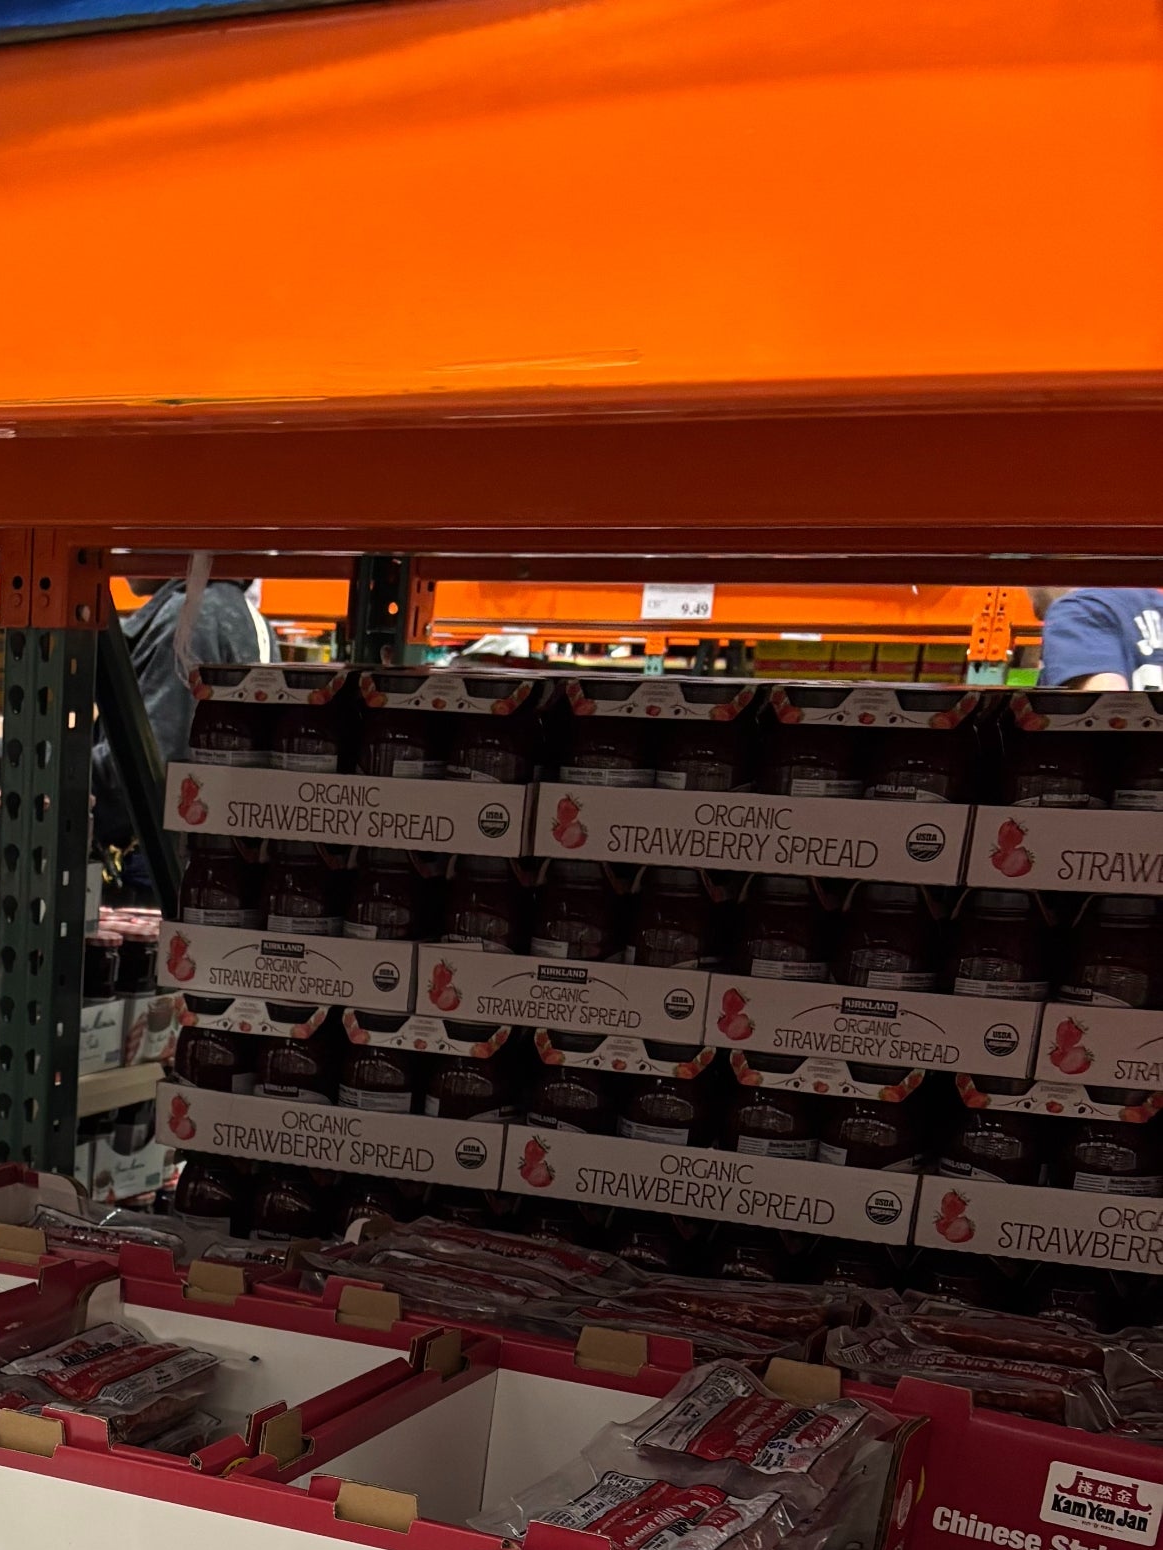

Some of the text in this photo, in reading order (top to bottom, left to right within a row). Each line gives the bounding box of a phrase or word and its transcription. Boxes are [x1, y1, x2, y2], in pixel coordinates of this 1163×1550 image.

[681, 603, 709, 615] 9.49
[298, 782, 380, 808] ORGANIC
[227, 801, 454, 842] STRAWBERRY SPREAD
[695, 803, 793, 830] ORGANIC
[608, 825, 879, 869] STRAWBERRY SPREAD
[915, 832, 937, 842] USDA
[1058, 850, 1163, 883] STRAW
[262, 941, 304, 953] KIRKLAND
[255, 957, 308, 975] ORGANIC
[539, 966, 587, 980] KIRKLAND
[209, 967, 354, 998] STRAWBERRY SPREAD
[529, 984, 590, 1004] ORGANIC
[476, 996, 642, 1029] STRAWBERRY SPREAD
[841, 999, 897, 1013] KIRKLAND
[833, 1017, 902, 1038] ORGANIC
[992, 1031, 1012, 1040] USDA
[773, 1028, 960, 1065] STRAWBERRY SPREAD
[282, 1111, 362, 1137] ORGANIC
[213, 1123, 434, 1173] STRAWBERRY SPREAD
[659, 1154, 754, 1185] ORGANIC
[575, 1167, 835, 1225] STRAWBERRY SPREAD
[998, 1222, 1163, 1265] STRAWBERR
[1051, 1493, 1150, 1533] Kam Yen Jan
